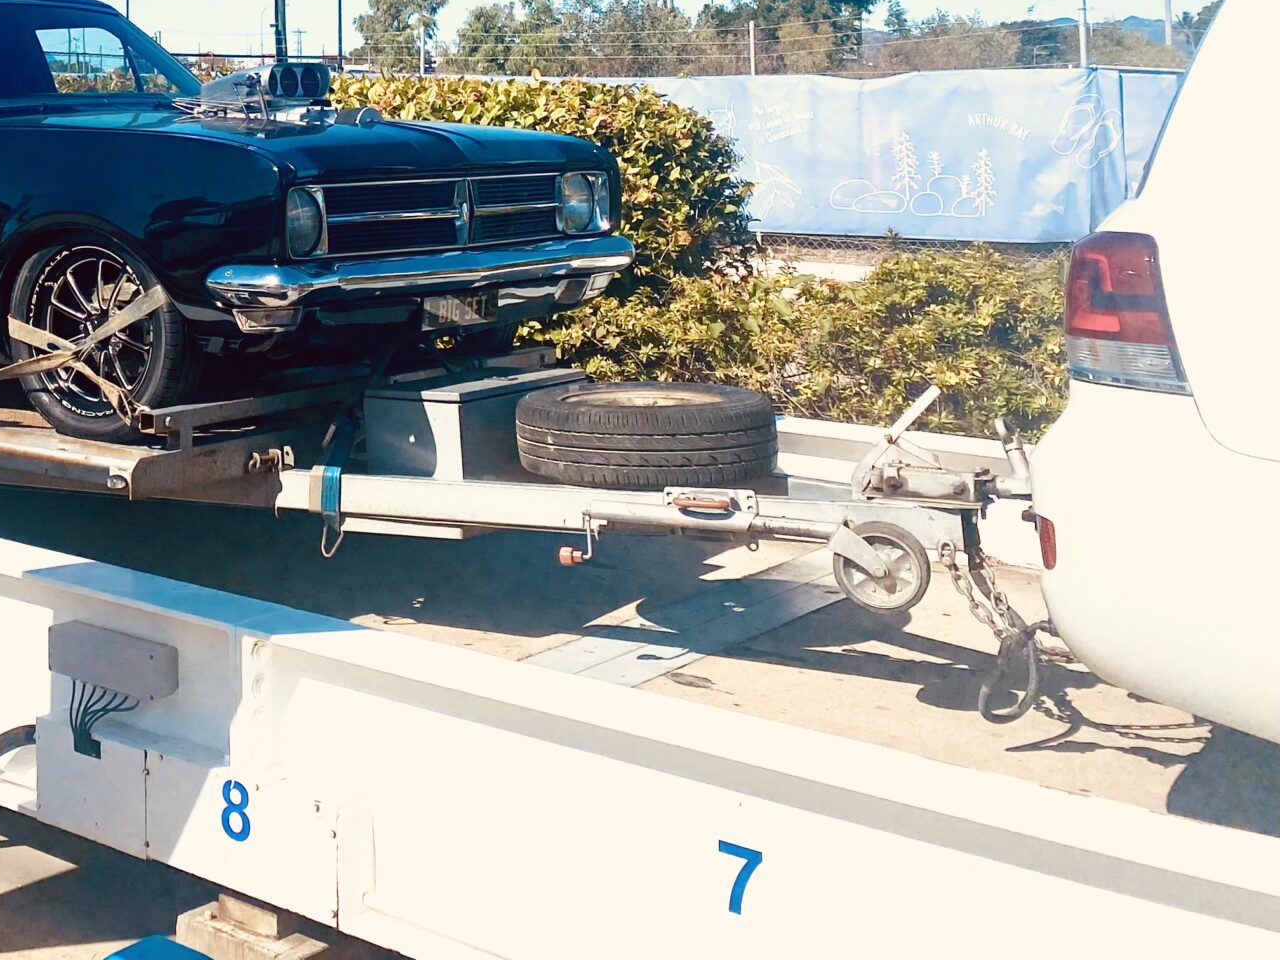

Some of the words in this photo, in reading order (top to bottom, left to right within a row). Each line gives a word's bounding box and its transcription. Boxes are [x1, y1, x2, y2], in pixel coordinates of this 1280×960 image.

[966, 112, 1009, 131] ARTHUR
[1007, 122, 1032, 141] BAY
[438, 300, 461, 324] BIG
[464, 294, 488, 321] SET
[60, 398, 115, 418] RACING
[220, 778, 251, 843] 8
[718, 839, 763, 916] 7
